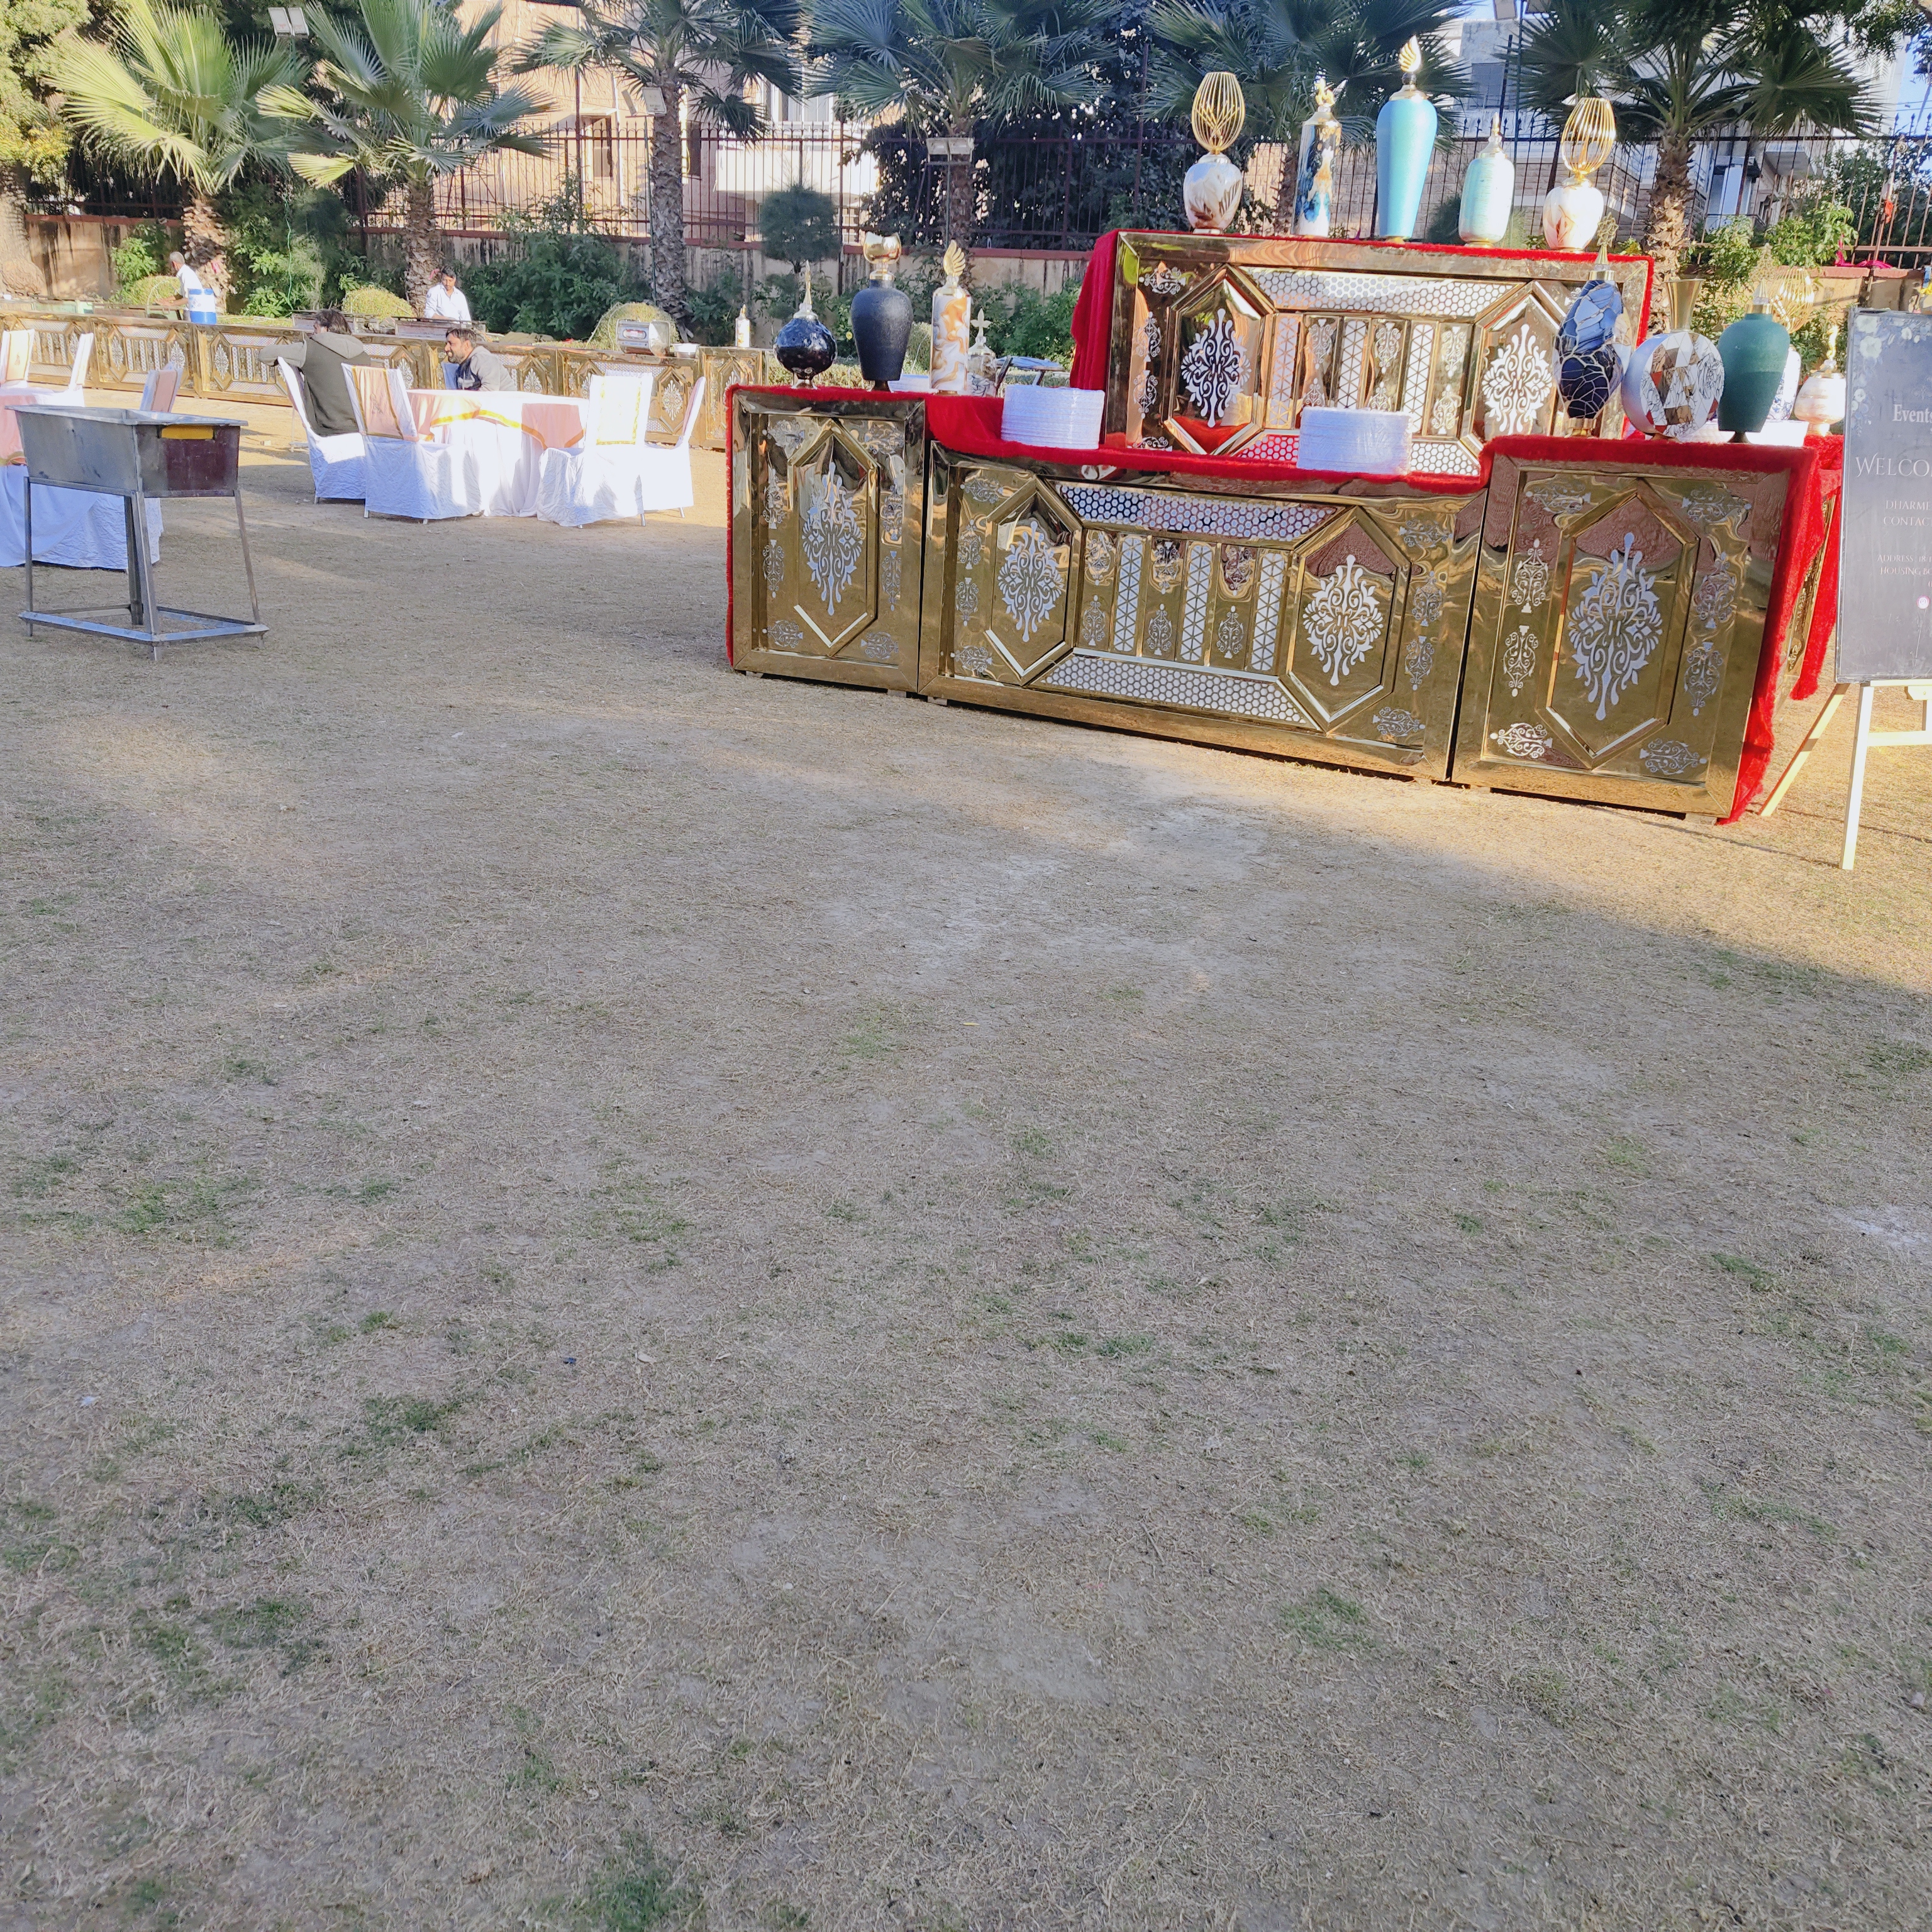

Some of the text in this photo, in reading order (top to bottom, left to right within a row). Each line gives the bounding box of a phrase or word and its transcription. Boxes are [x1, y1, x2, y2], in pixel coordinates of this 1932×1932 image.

[1855, 452, 1932, 477] WELCO
[1877, 554, 1914, 564] ADDRESS
[1880, 567, 1921, 575] HOUSING
